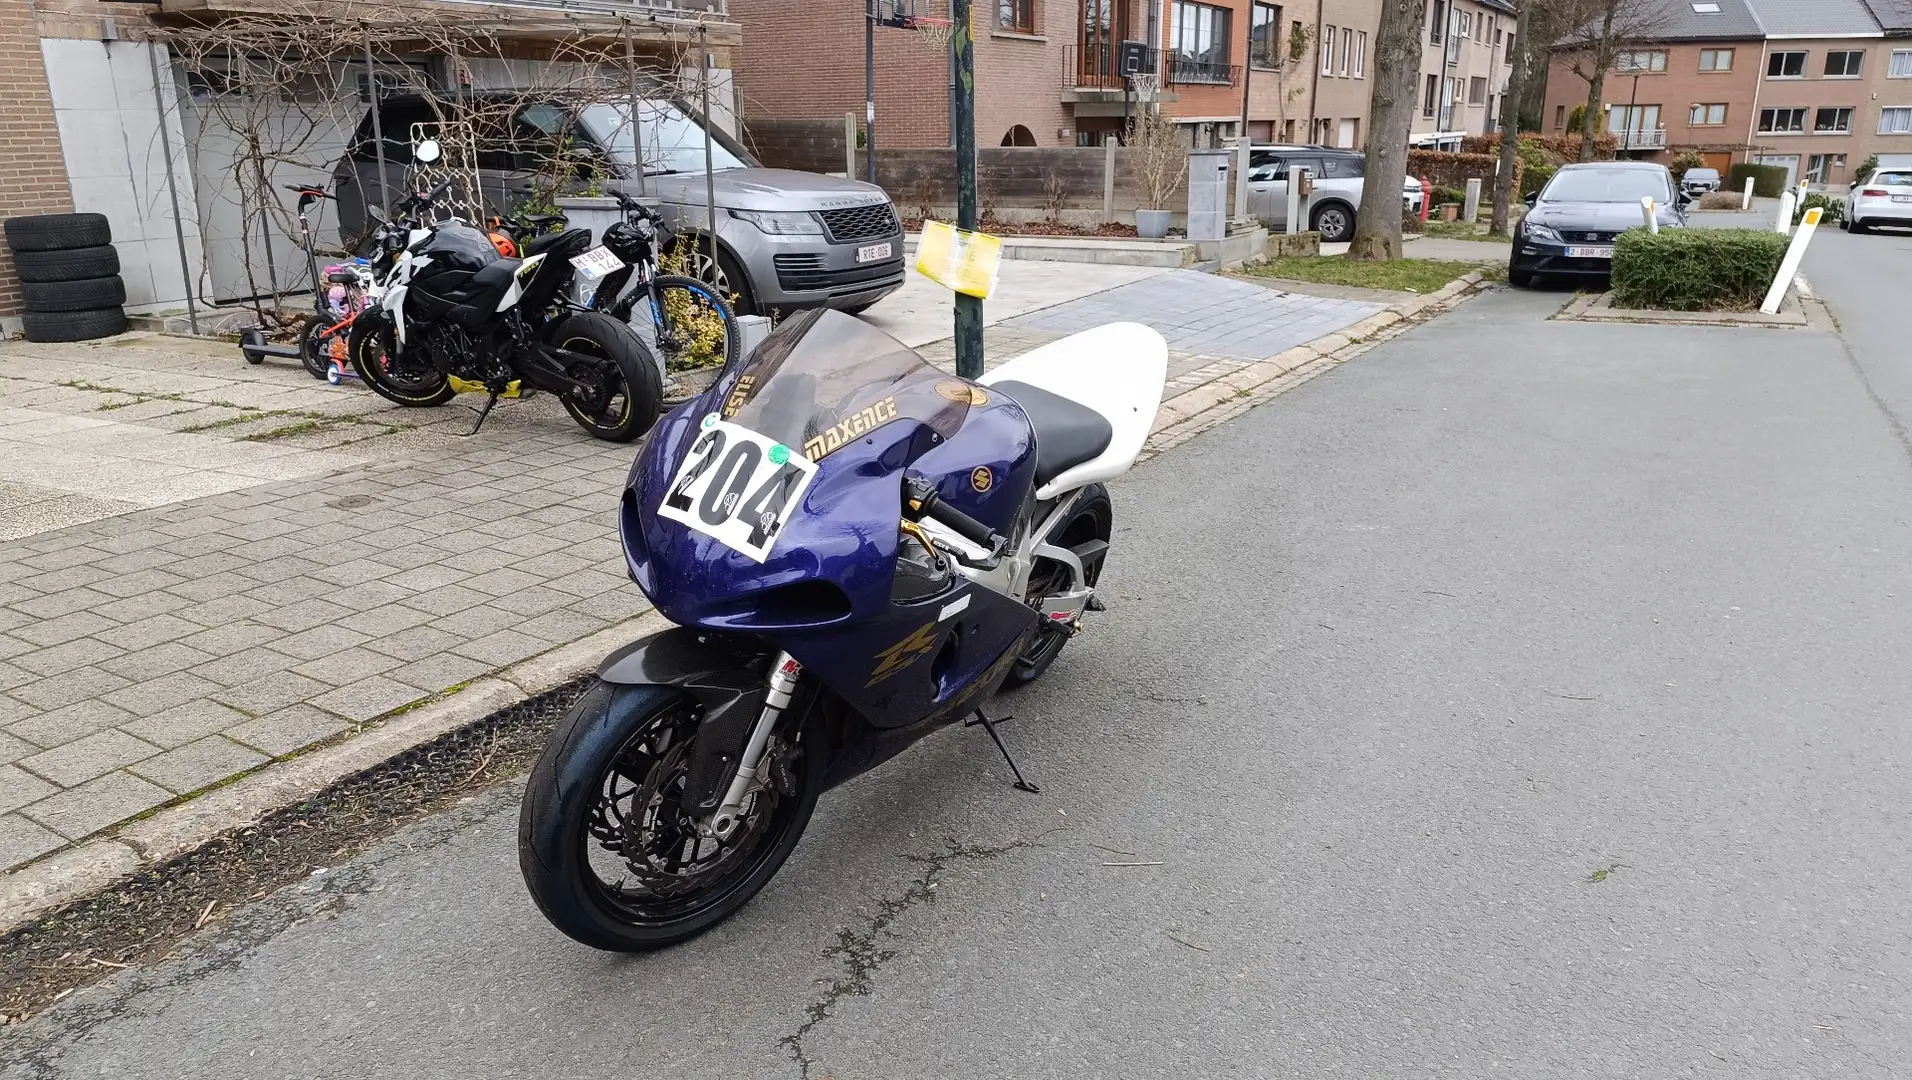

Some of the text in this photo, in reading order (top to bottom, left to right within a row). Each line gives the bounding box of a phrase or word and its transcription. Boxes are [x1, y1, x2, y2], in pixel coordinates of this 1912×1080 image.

[724, 375, 756, 417] ELISE
[804, 396, 897, 461] MAXENCE
[665, 429, 806, 549] 204
